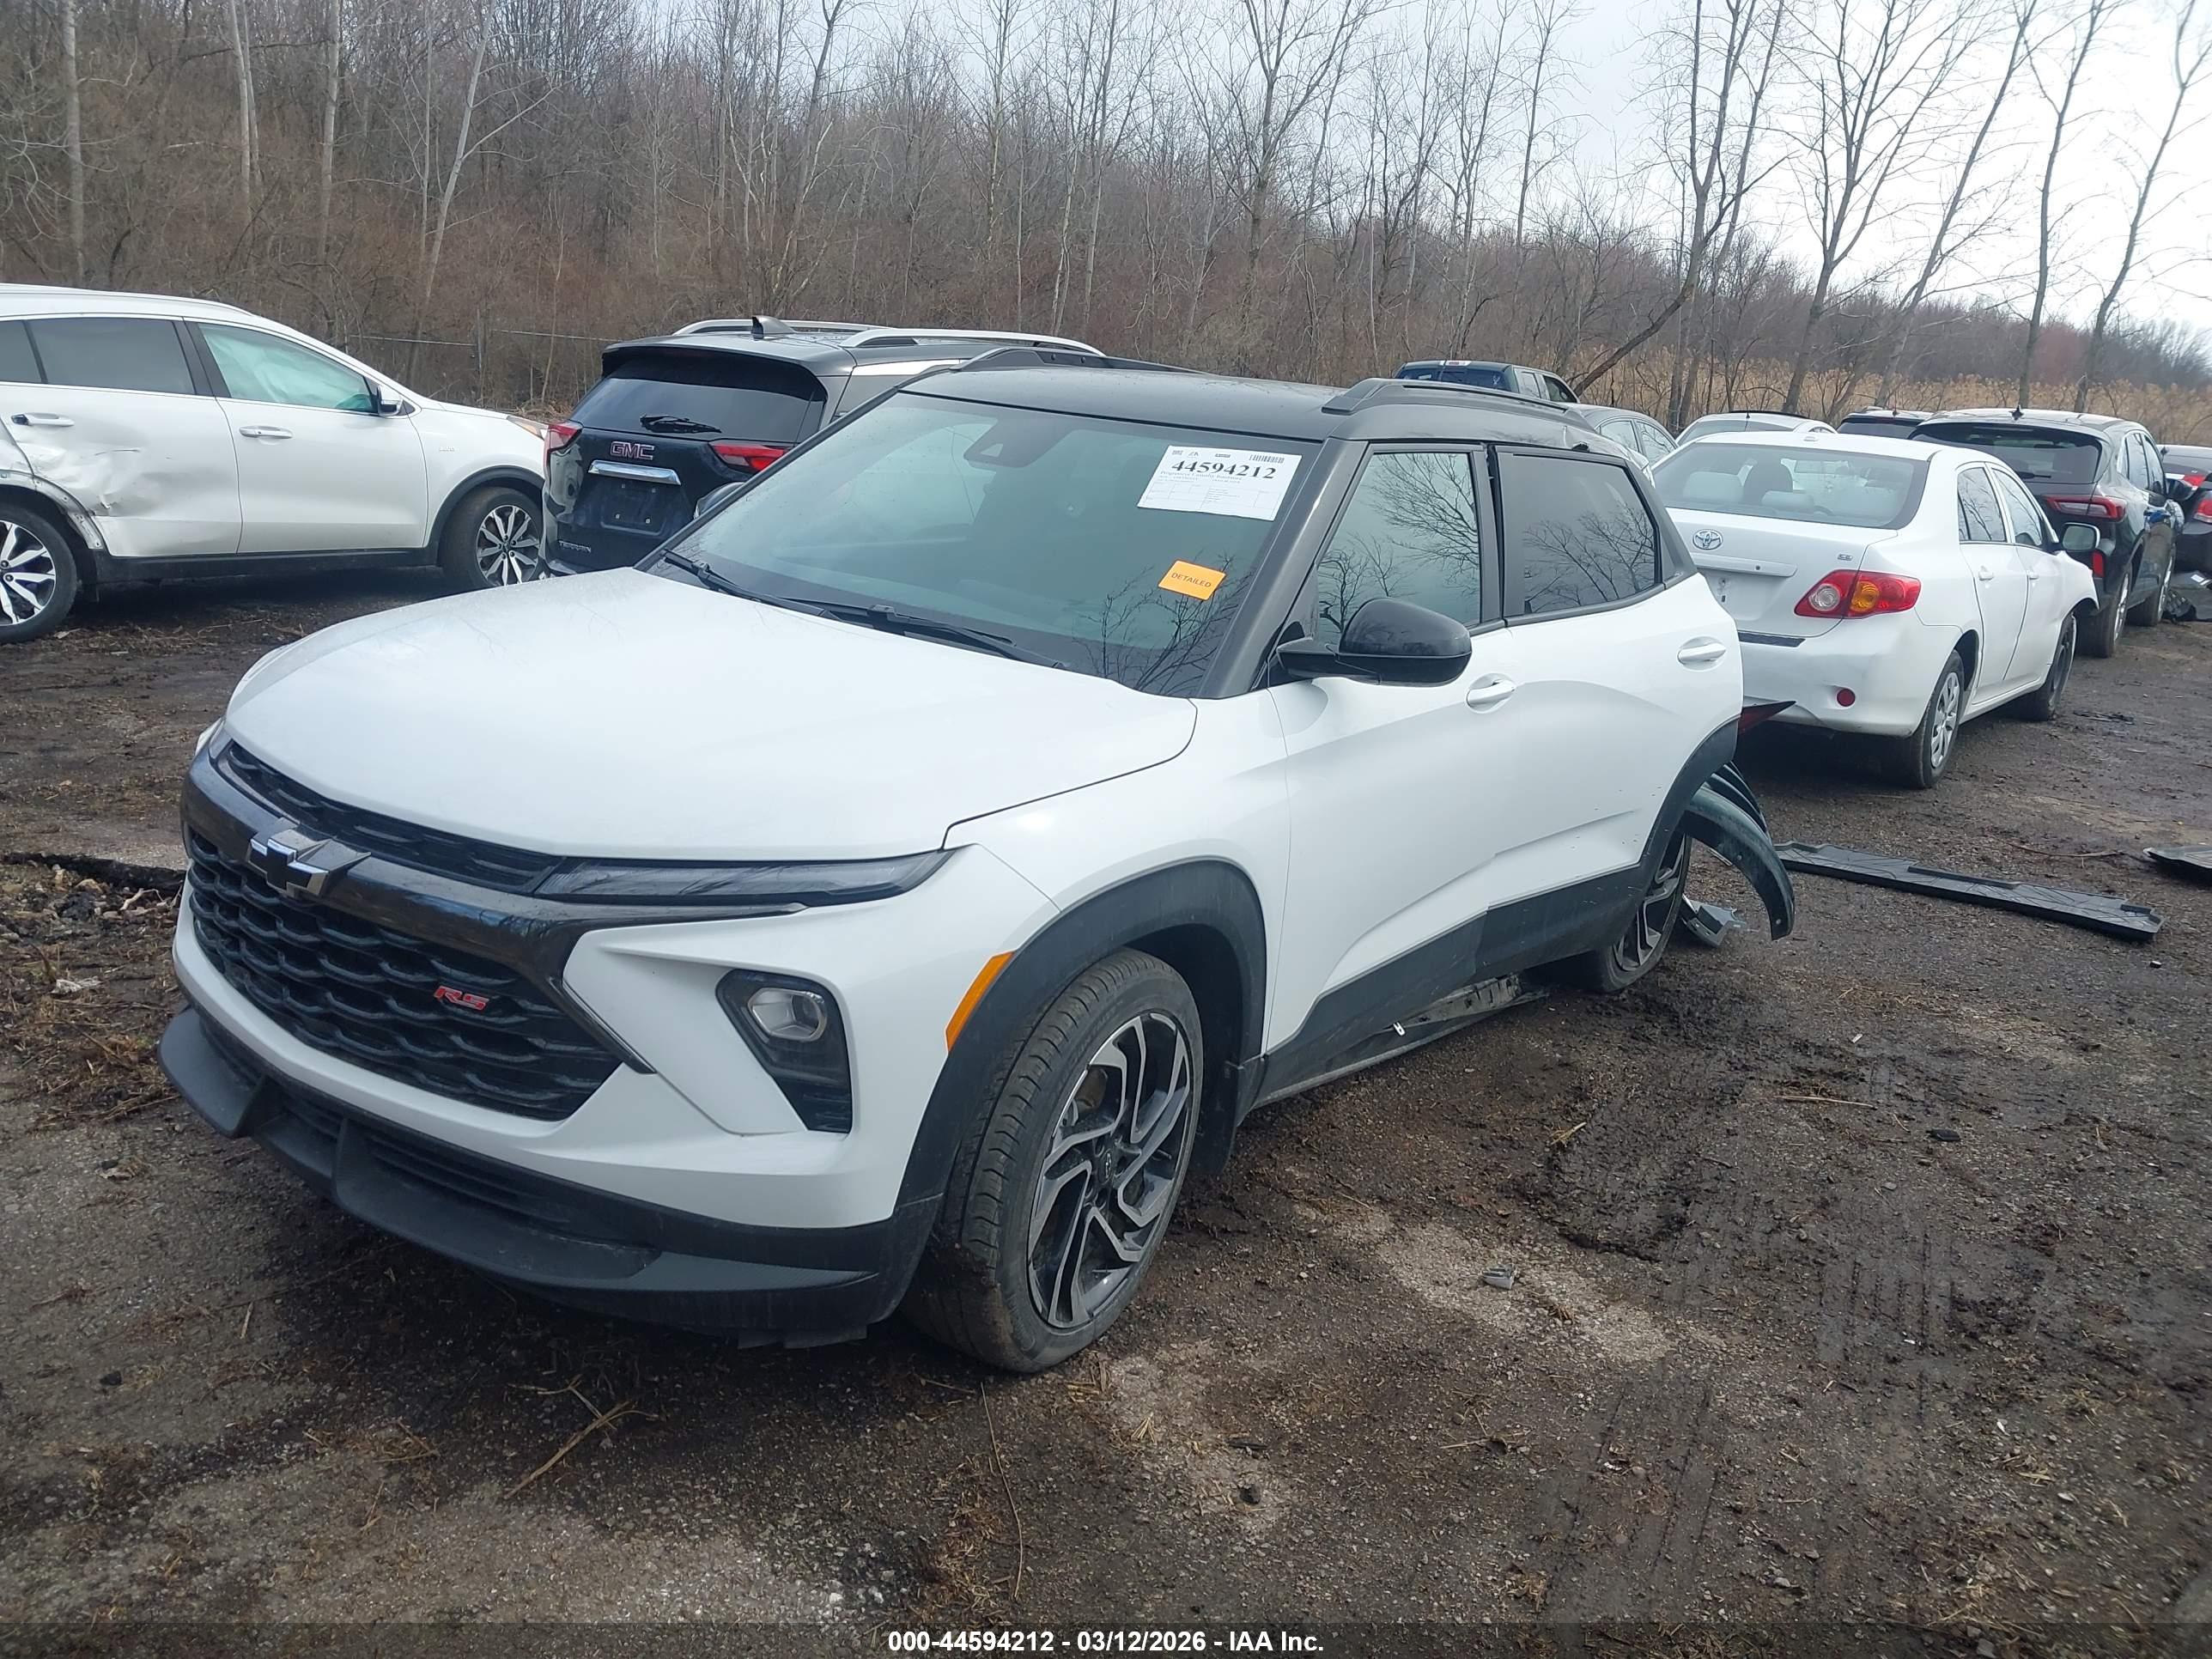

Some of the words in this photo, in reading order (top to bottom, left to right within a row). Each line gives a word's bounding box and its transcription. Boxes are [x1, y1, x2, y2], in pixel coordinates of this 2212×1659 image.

[611, 441, 654, 460] GMC
[1171, 460, 1276, 479] 44594212
[1171, 572, 1212, 588] DETAILED
[434, 986, 489, 1010] RS
